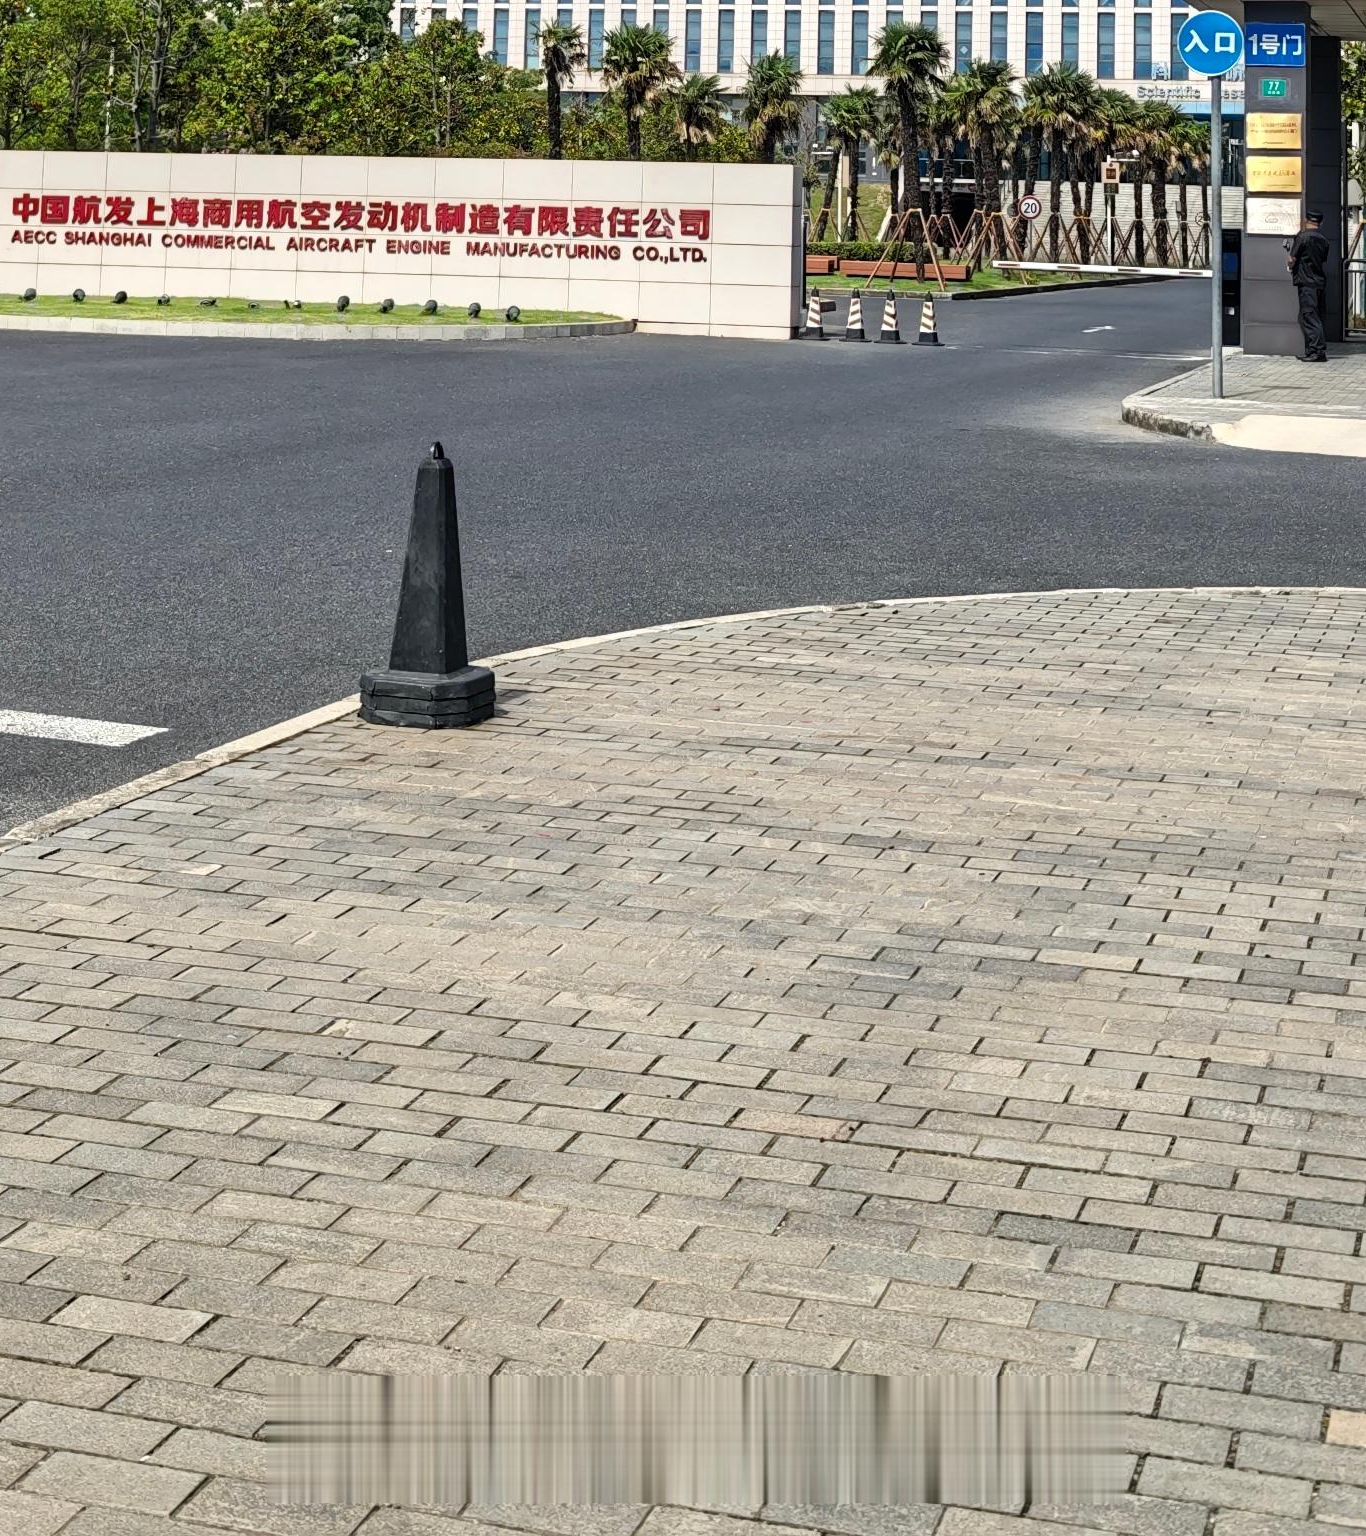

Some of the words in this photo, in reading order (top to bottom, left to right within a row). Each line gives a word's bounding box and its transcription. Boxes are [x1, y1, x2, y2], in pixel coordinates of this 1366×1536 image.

[1184, 29, 1236, 54] 入口
[1248, 33, 1302, 56] 1号门
[1137, 86, 1201, 99] Scientific
[1268, 81, 1280, 91] 77
[12, 193, 711, 241] 中国航发上海商用航空发动机制造有限责任公司
[1023, 202, 1038, 214] 20
[11, 230, 57, 245] AECC
[64, 232, 152, 248] SHANGHAI
[161, 234, 276, 251] COMMERCIAL
[286, 237, 377, 254] AIRCRAFT
[386, 239, 451, 256] ENGINE
[466, 241, 621, 261] MANUFACTURING
[632, 245, 708, 265] CO.,LTD.
